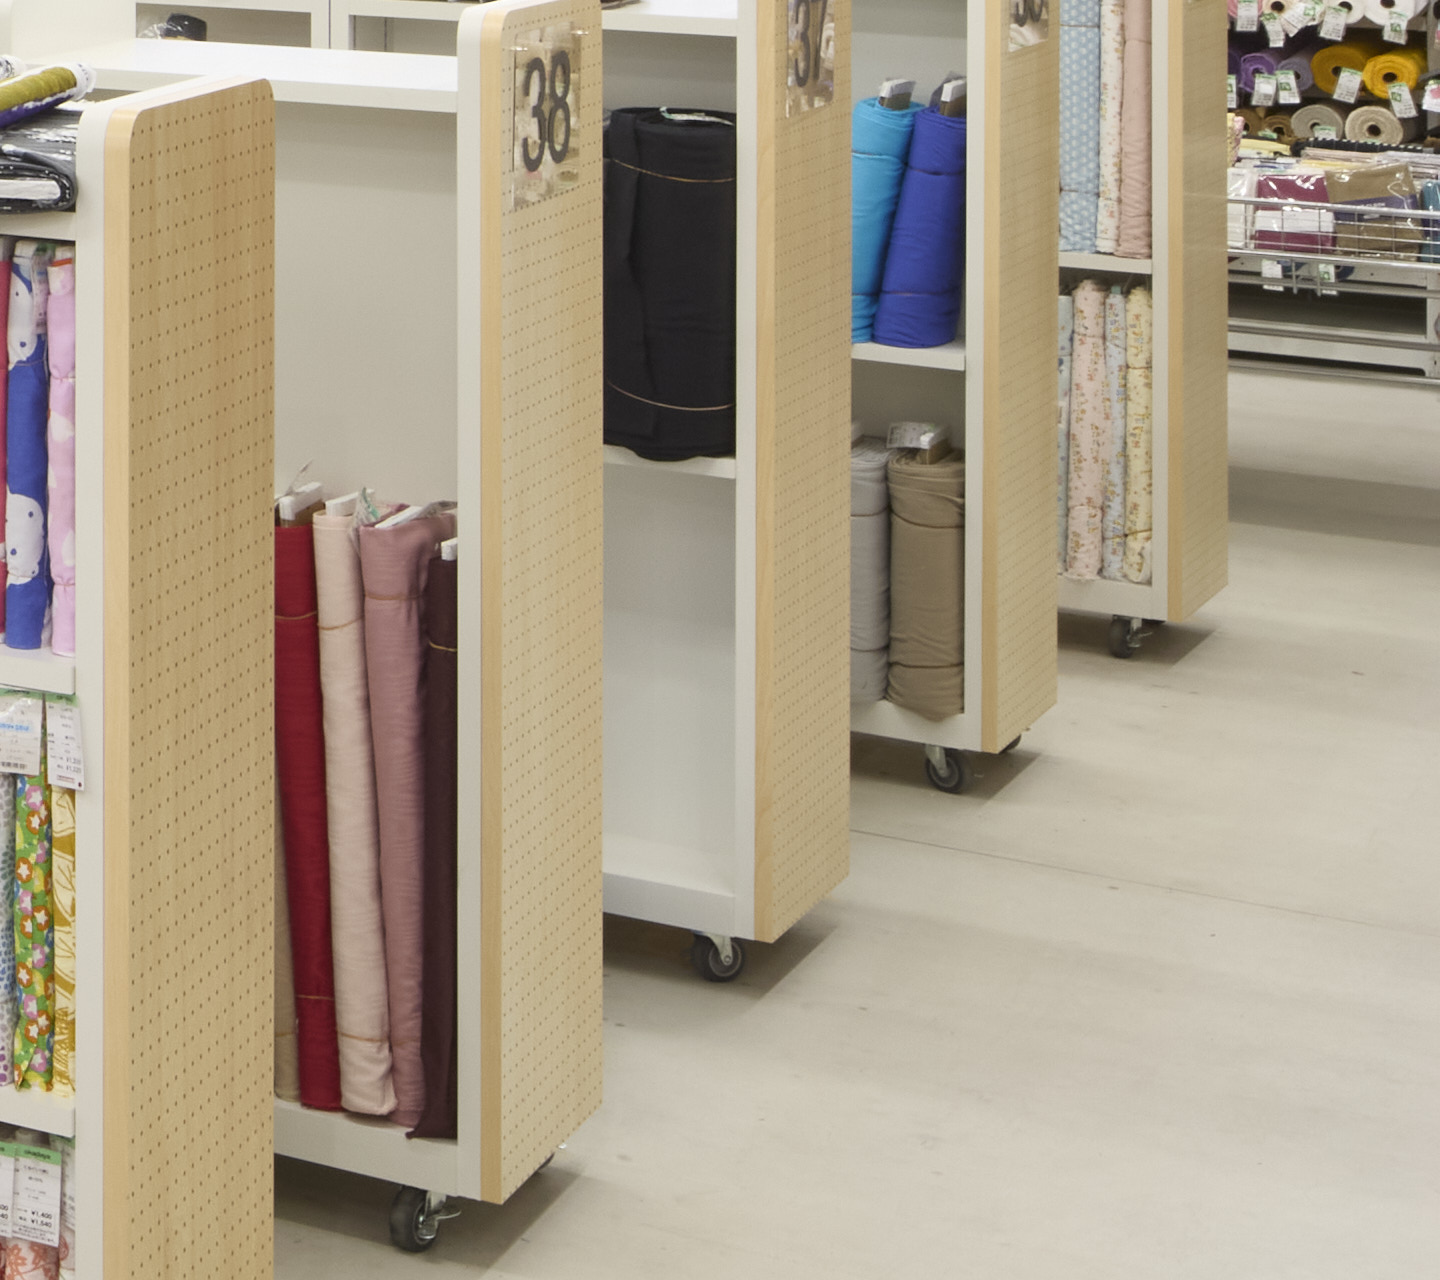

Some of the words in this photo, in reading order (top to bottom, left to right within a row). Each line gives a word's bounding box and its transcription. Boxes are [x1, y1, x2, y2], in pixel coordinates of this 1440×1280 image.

[522, 50, 571, 173] 38
[31, 1210, 52, 1220] ¥1,400
[30, 1218, 52, 1228] ¥1,540
